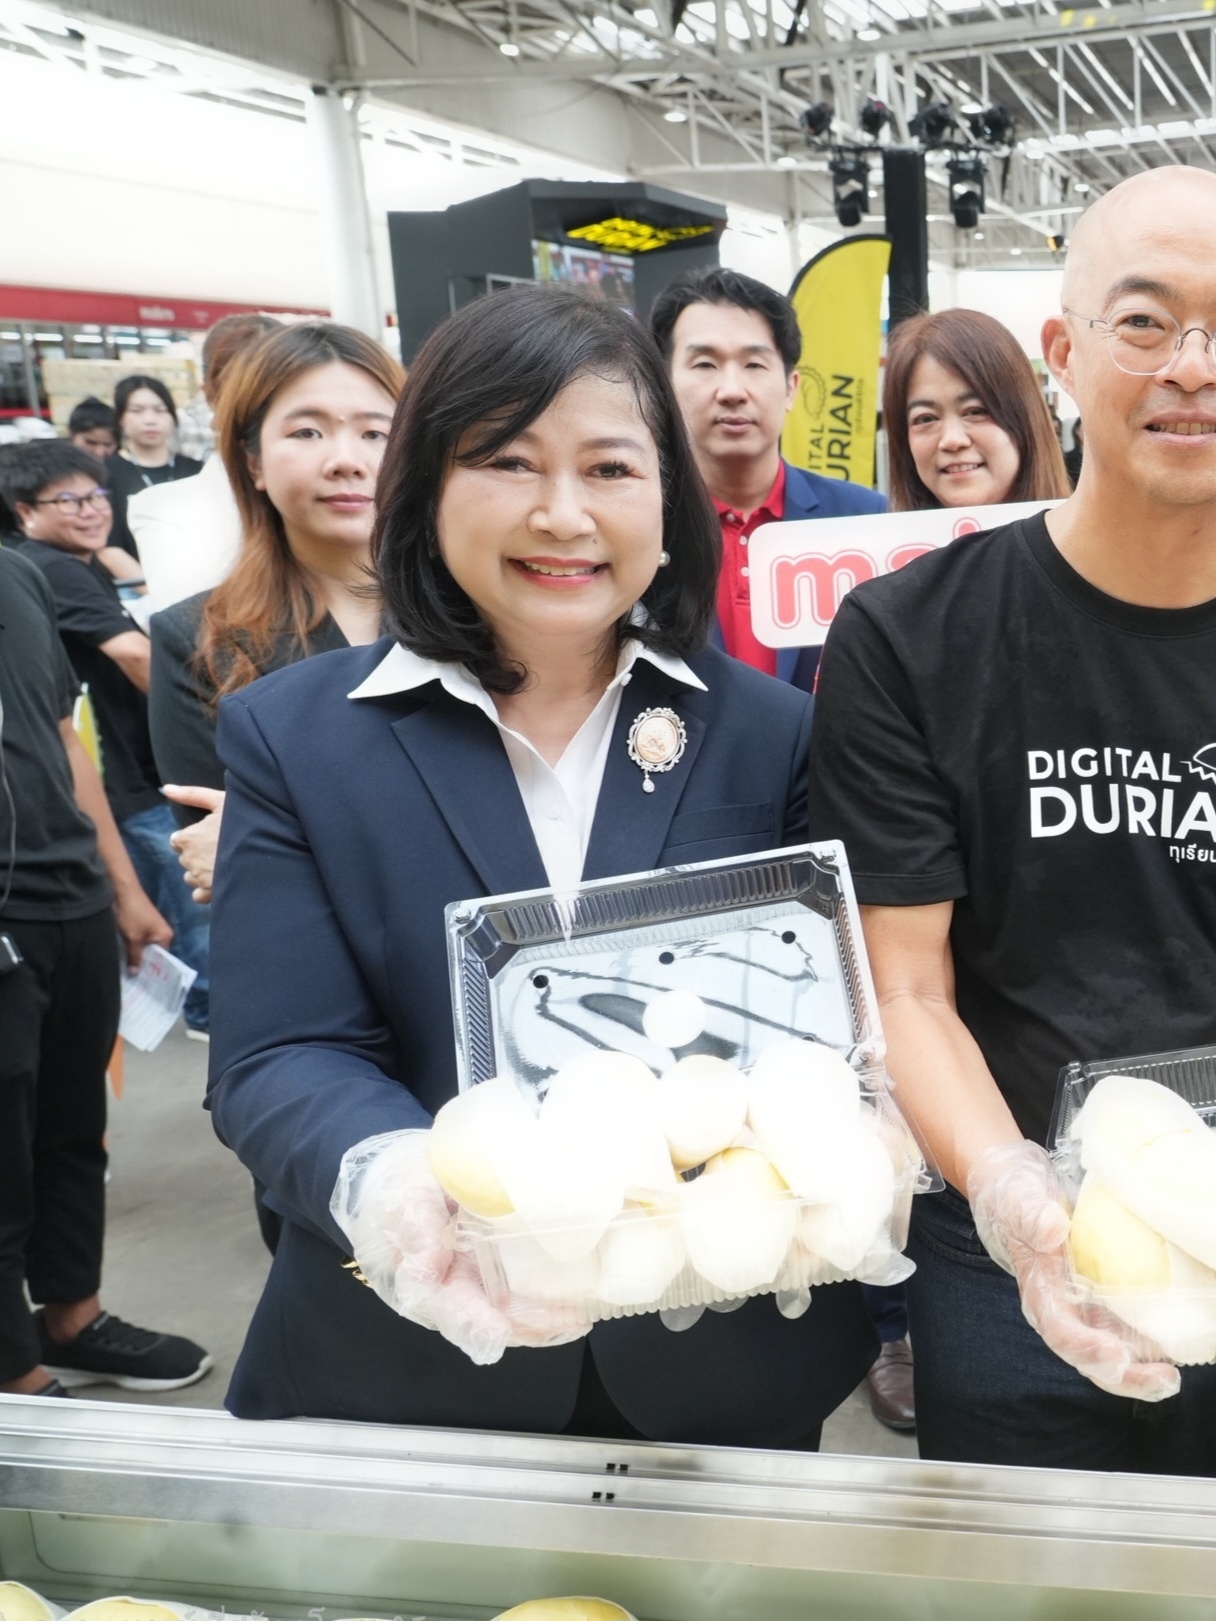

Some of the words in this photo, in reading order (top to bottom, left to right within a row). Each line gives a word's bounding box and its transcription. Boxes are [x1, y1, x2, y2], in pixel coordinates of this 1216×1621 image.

[808, 424, 825, 470] ITAL
[826, 374, 855, 482] URIAN
[1027, 747, 1182, 783] DIGITAL
